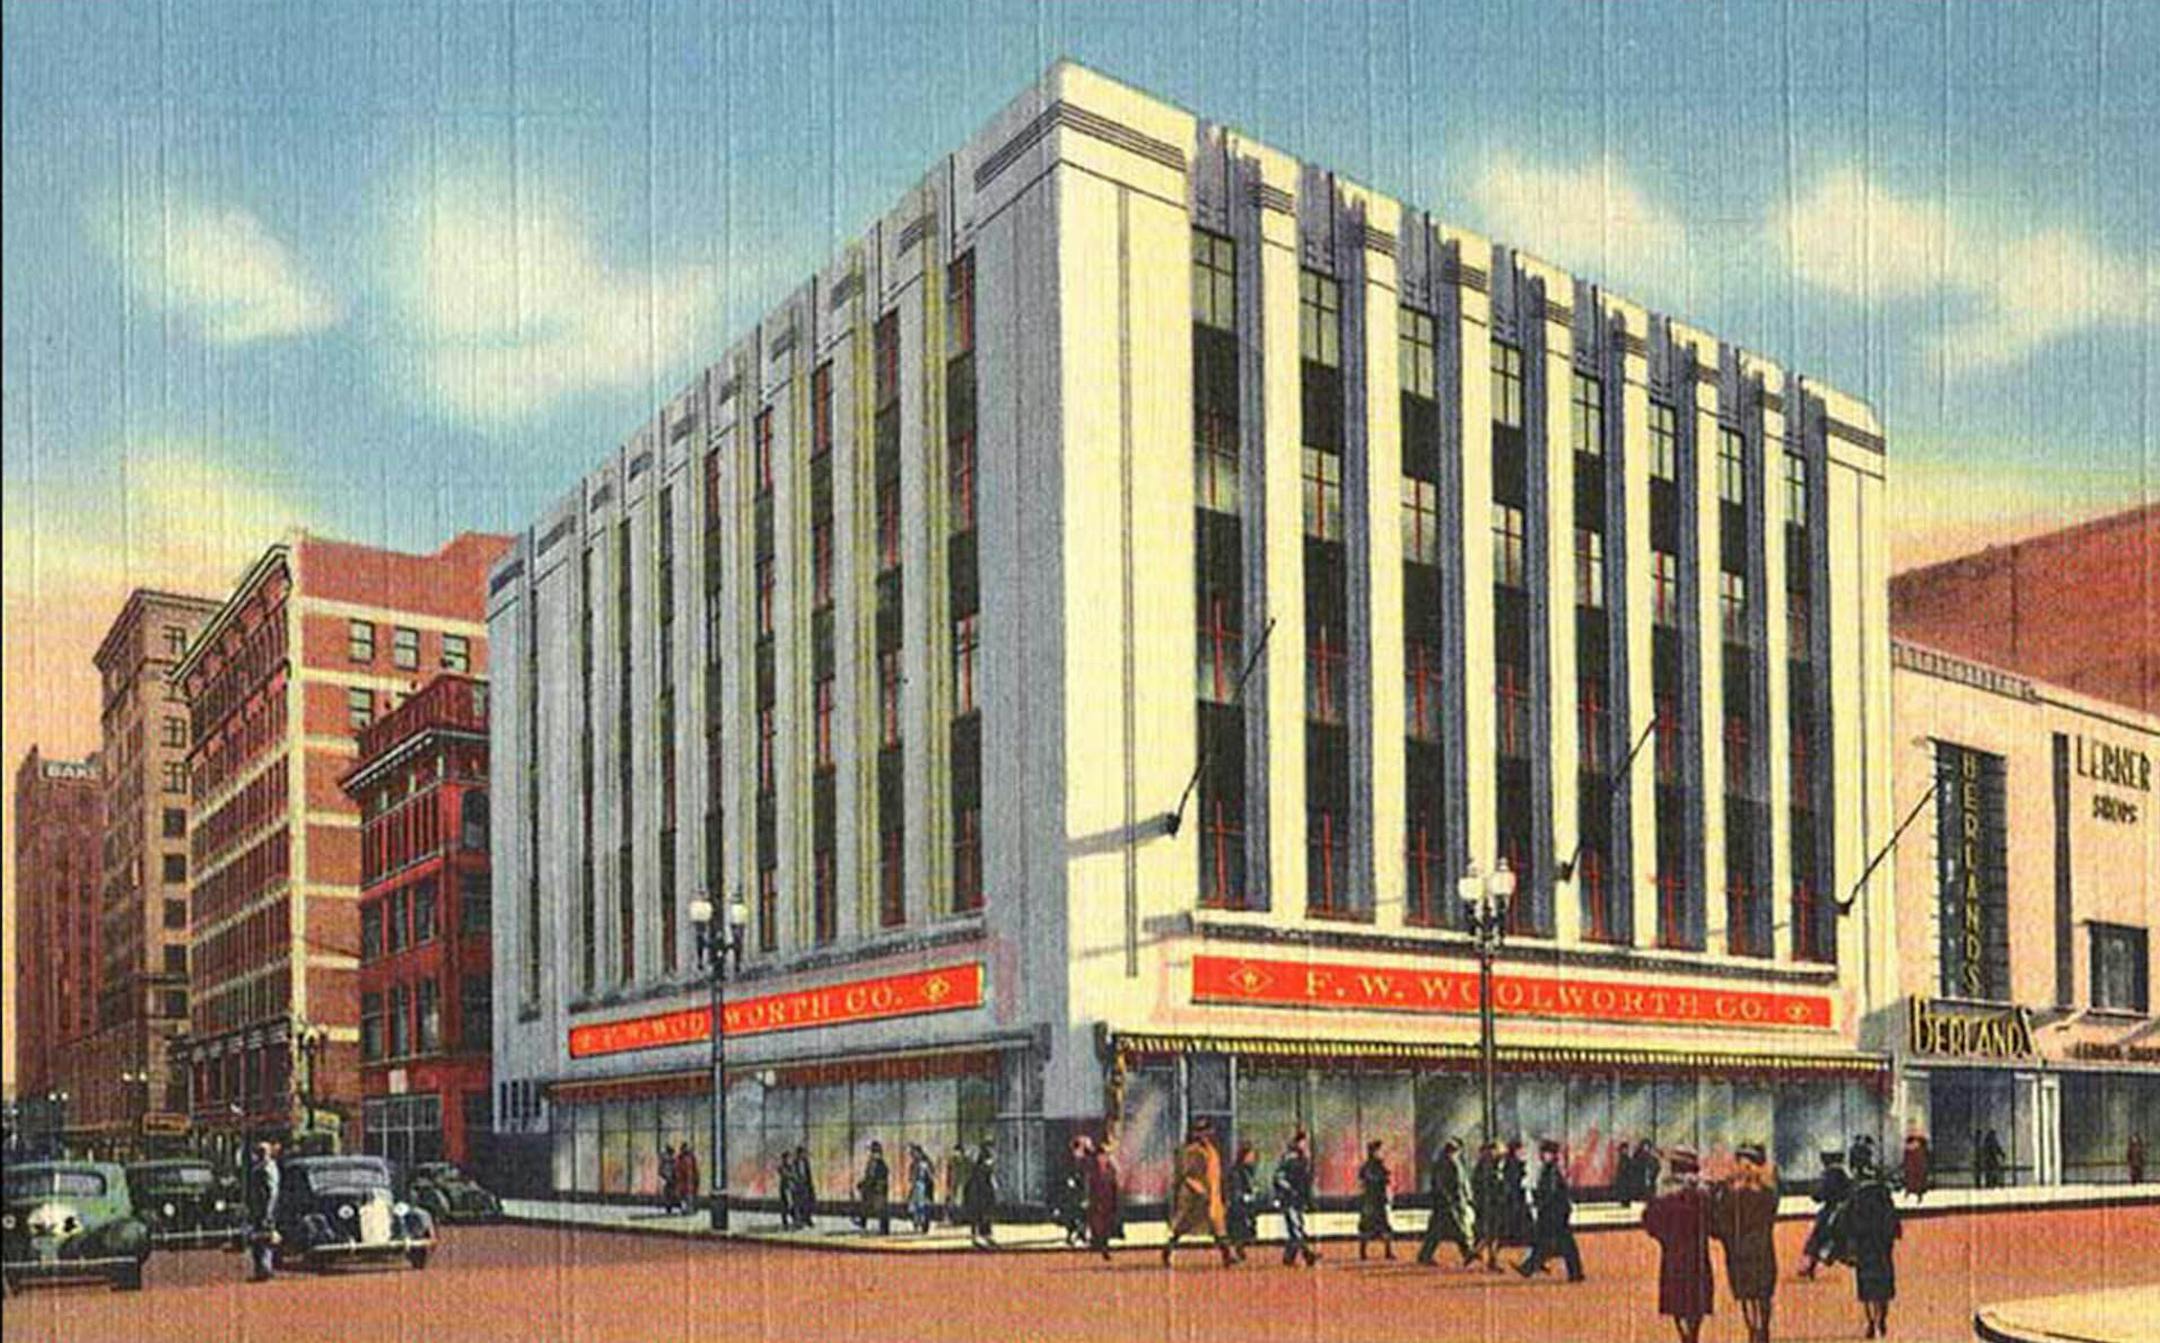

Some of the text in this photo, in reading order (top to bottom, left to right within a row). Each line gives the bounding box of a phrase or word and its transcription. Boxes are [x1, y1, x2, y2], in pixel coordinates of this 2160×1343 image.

[2076, 733, 2151, 792] LERNER
[845, 985, 904, 1013] CO.
[1305, 969, 1346, 998] F.
[1358, 973, 1405, 999] W.
[1909, 994, 2041, 1059] BERLANDS
